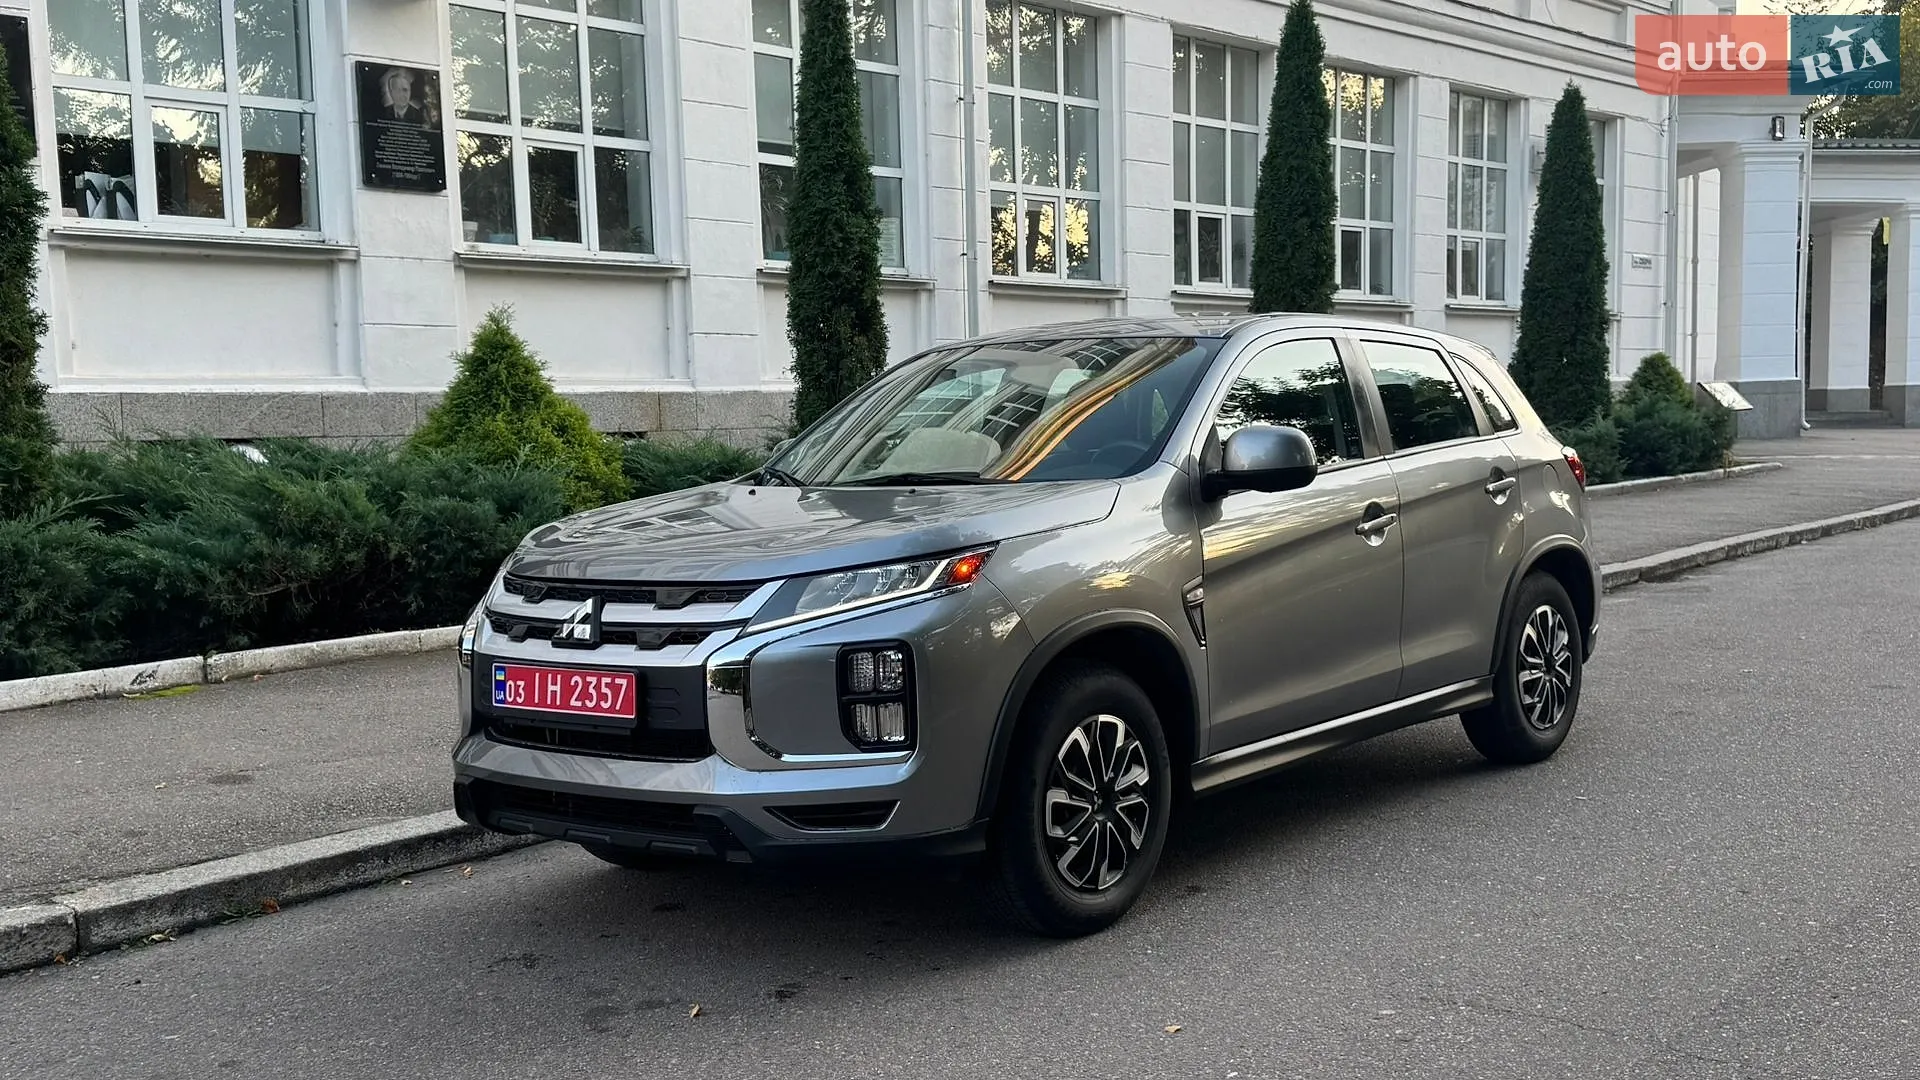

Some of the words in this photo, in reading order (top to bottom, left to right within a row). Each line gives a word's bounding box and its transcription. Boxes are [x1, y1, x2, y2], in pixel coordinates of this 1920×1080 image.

[495, 690, 504, 700] UA
[506, 680, 525, 703] 03
[569, 675, 627, 710] 2357
